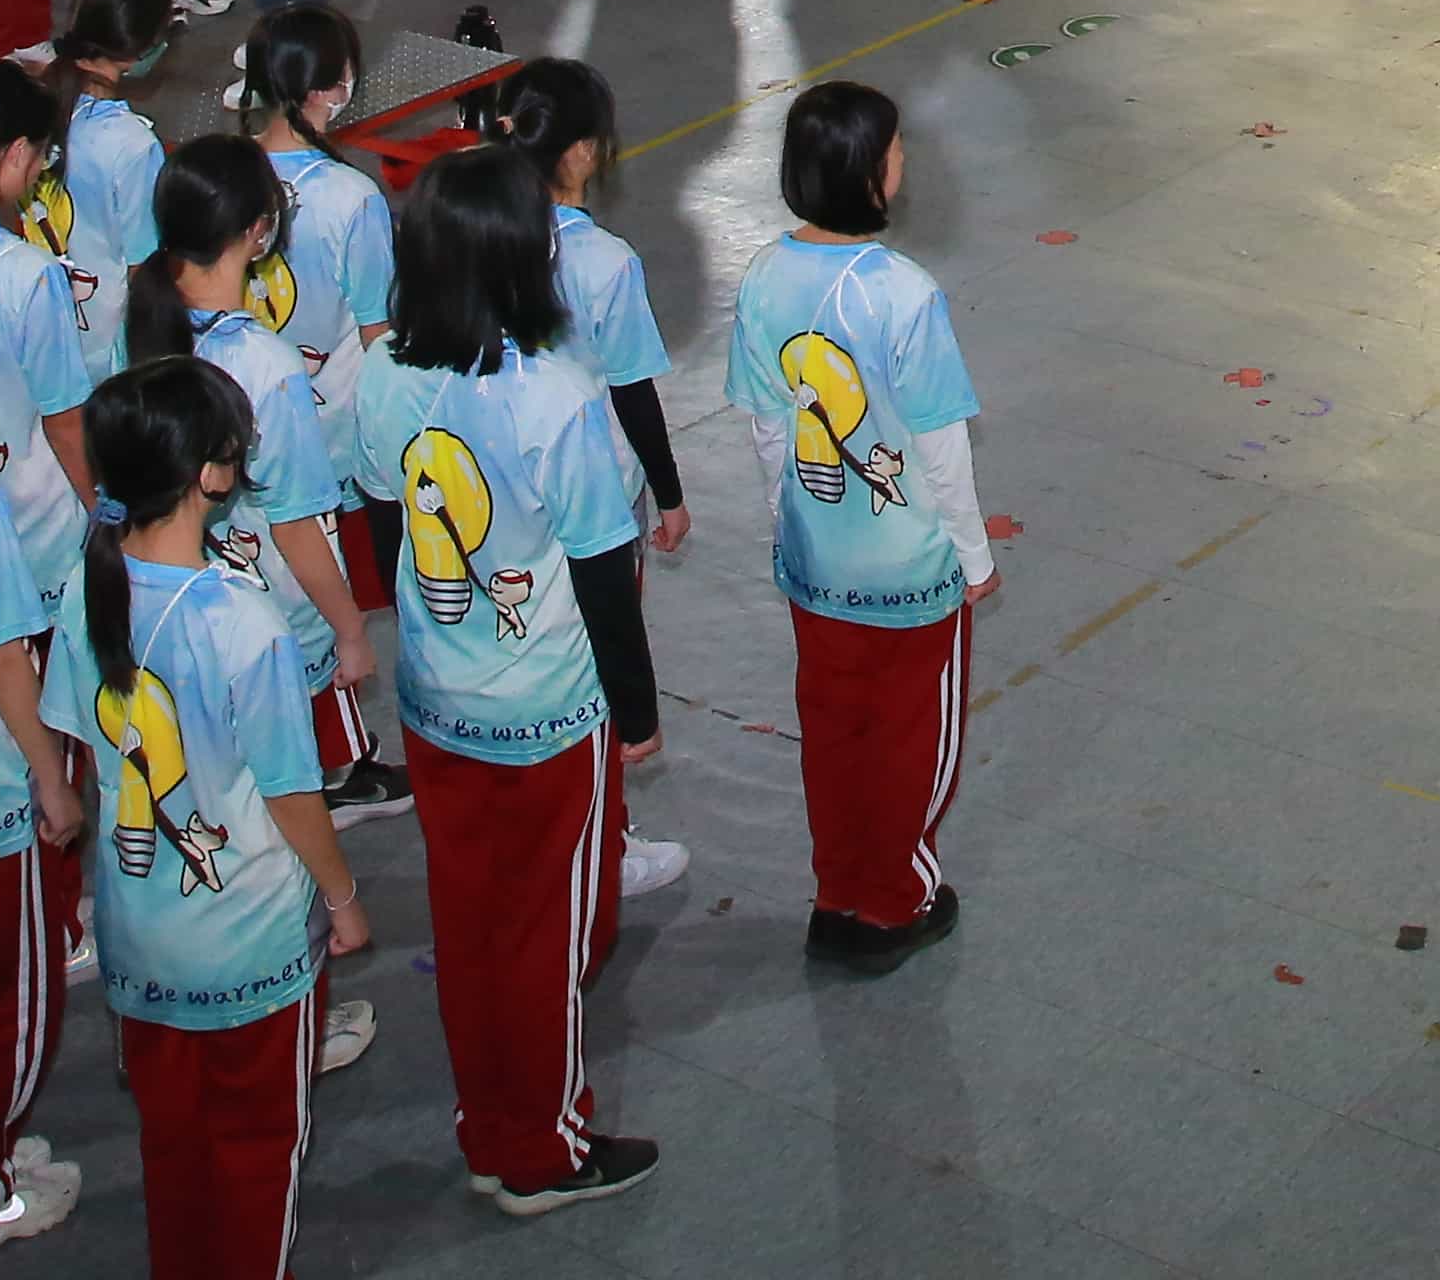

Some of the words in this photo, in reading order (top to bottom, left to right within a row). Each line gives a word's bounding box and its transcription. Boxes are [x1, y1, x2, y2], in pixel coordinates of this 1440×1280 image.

[846, 589, 874, 607] Be
[455, 718, 483, 740] Be
[491, 696, 601, 741] warmer
[144, 981, 177, 1003] Be
[187, 951, 308, 1006] warmer
